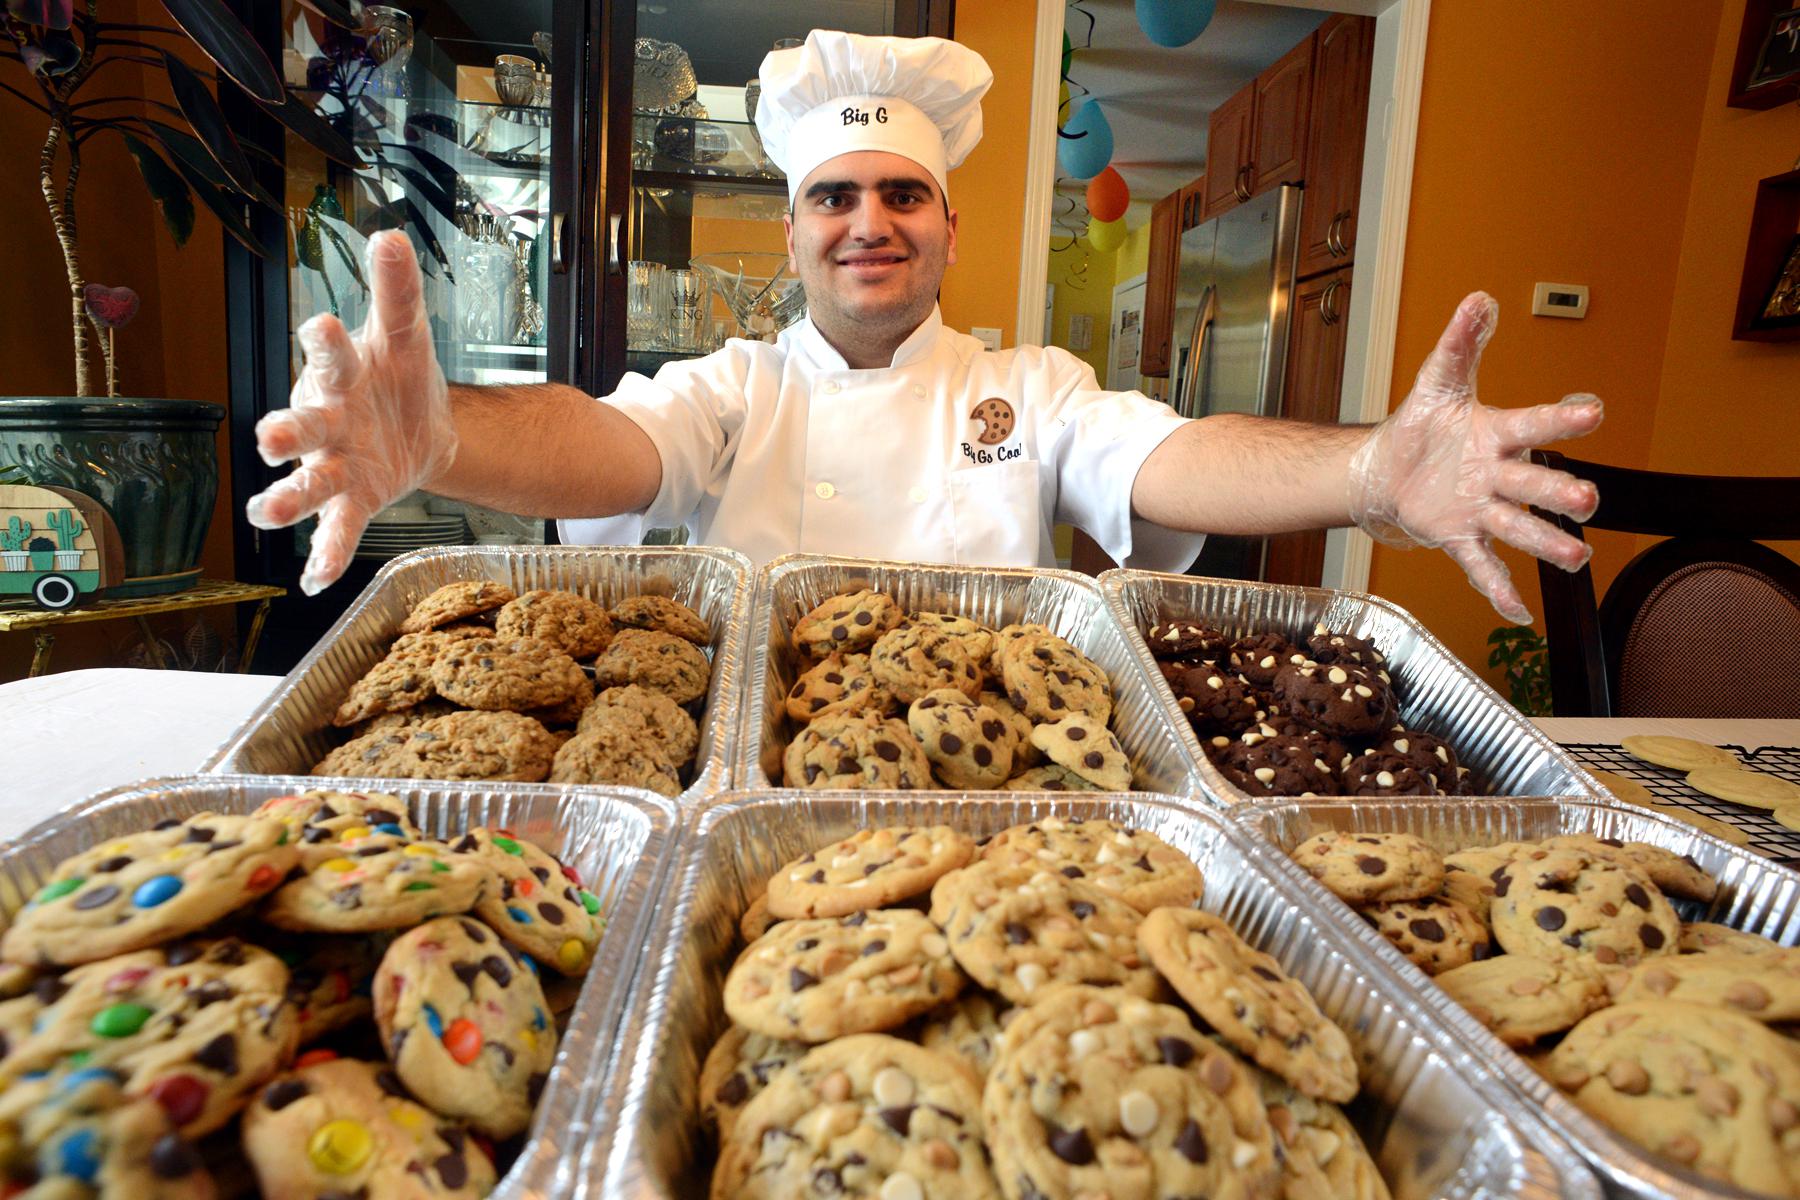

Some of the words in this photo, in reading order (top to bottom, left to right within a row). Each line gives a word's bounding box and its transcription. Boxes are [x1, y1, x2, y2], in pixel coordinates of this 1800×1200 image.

[841, 107, 869, 126] Big
[876, 107, 888, 124] G
[977, 450, 993, 464] Gs
